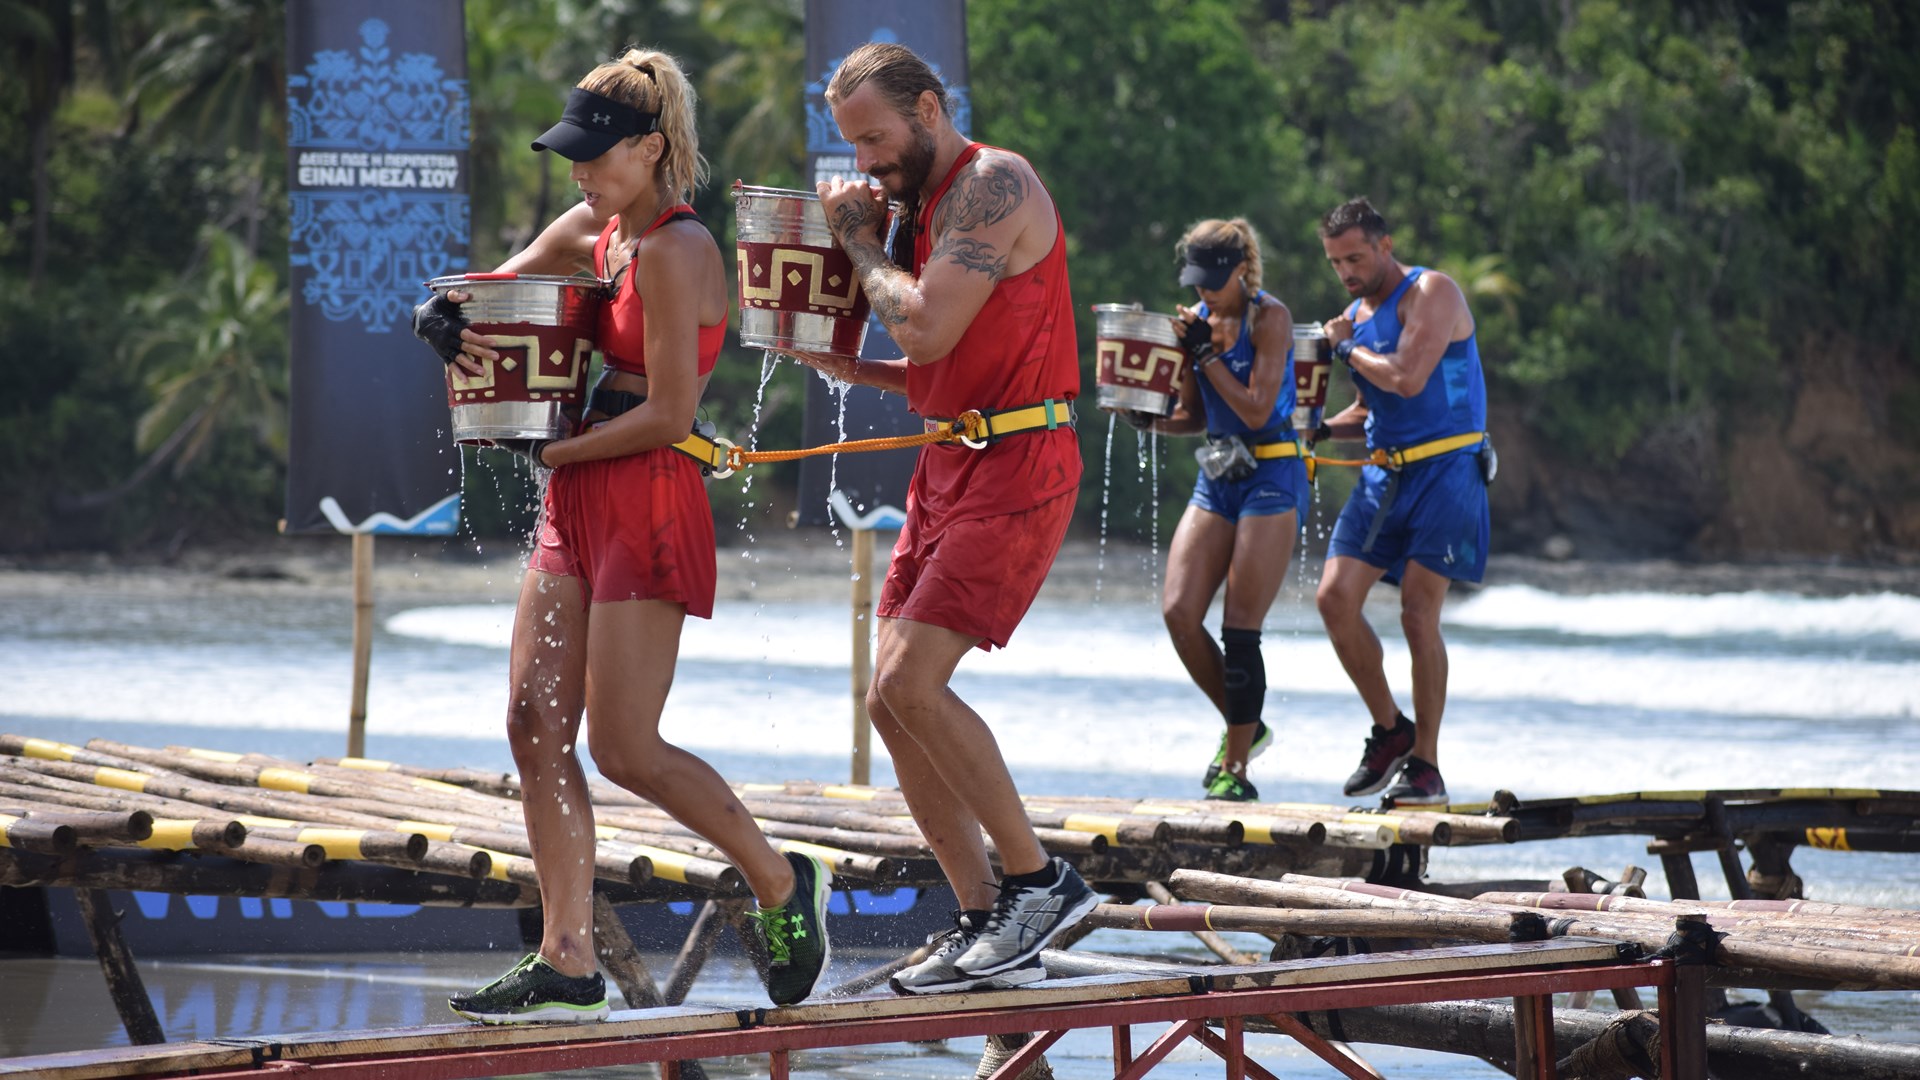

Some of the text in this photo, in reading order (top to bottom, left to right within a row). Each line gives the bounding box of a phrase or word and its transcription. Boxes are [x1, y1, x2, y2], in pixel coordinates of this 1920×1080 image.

[340, 152, 369, 167] ΠΩΣ
[371, 153, 382, 167] Η
[298, 167, 459, 189] ΕΙΝΑΙ ΜΕΣΑ ΣΟΥ
